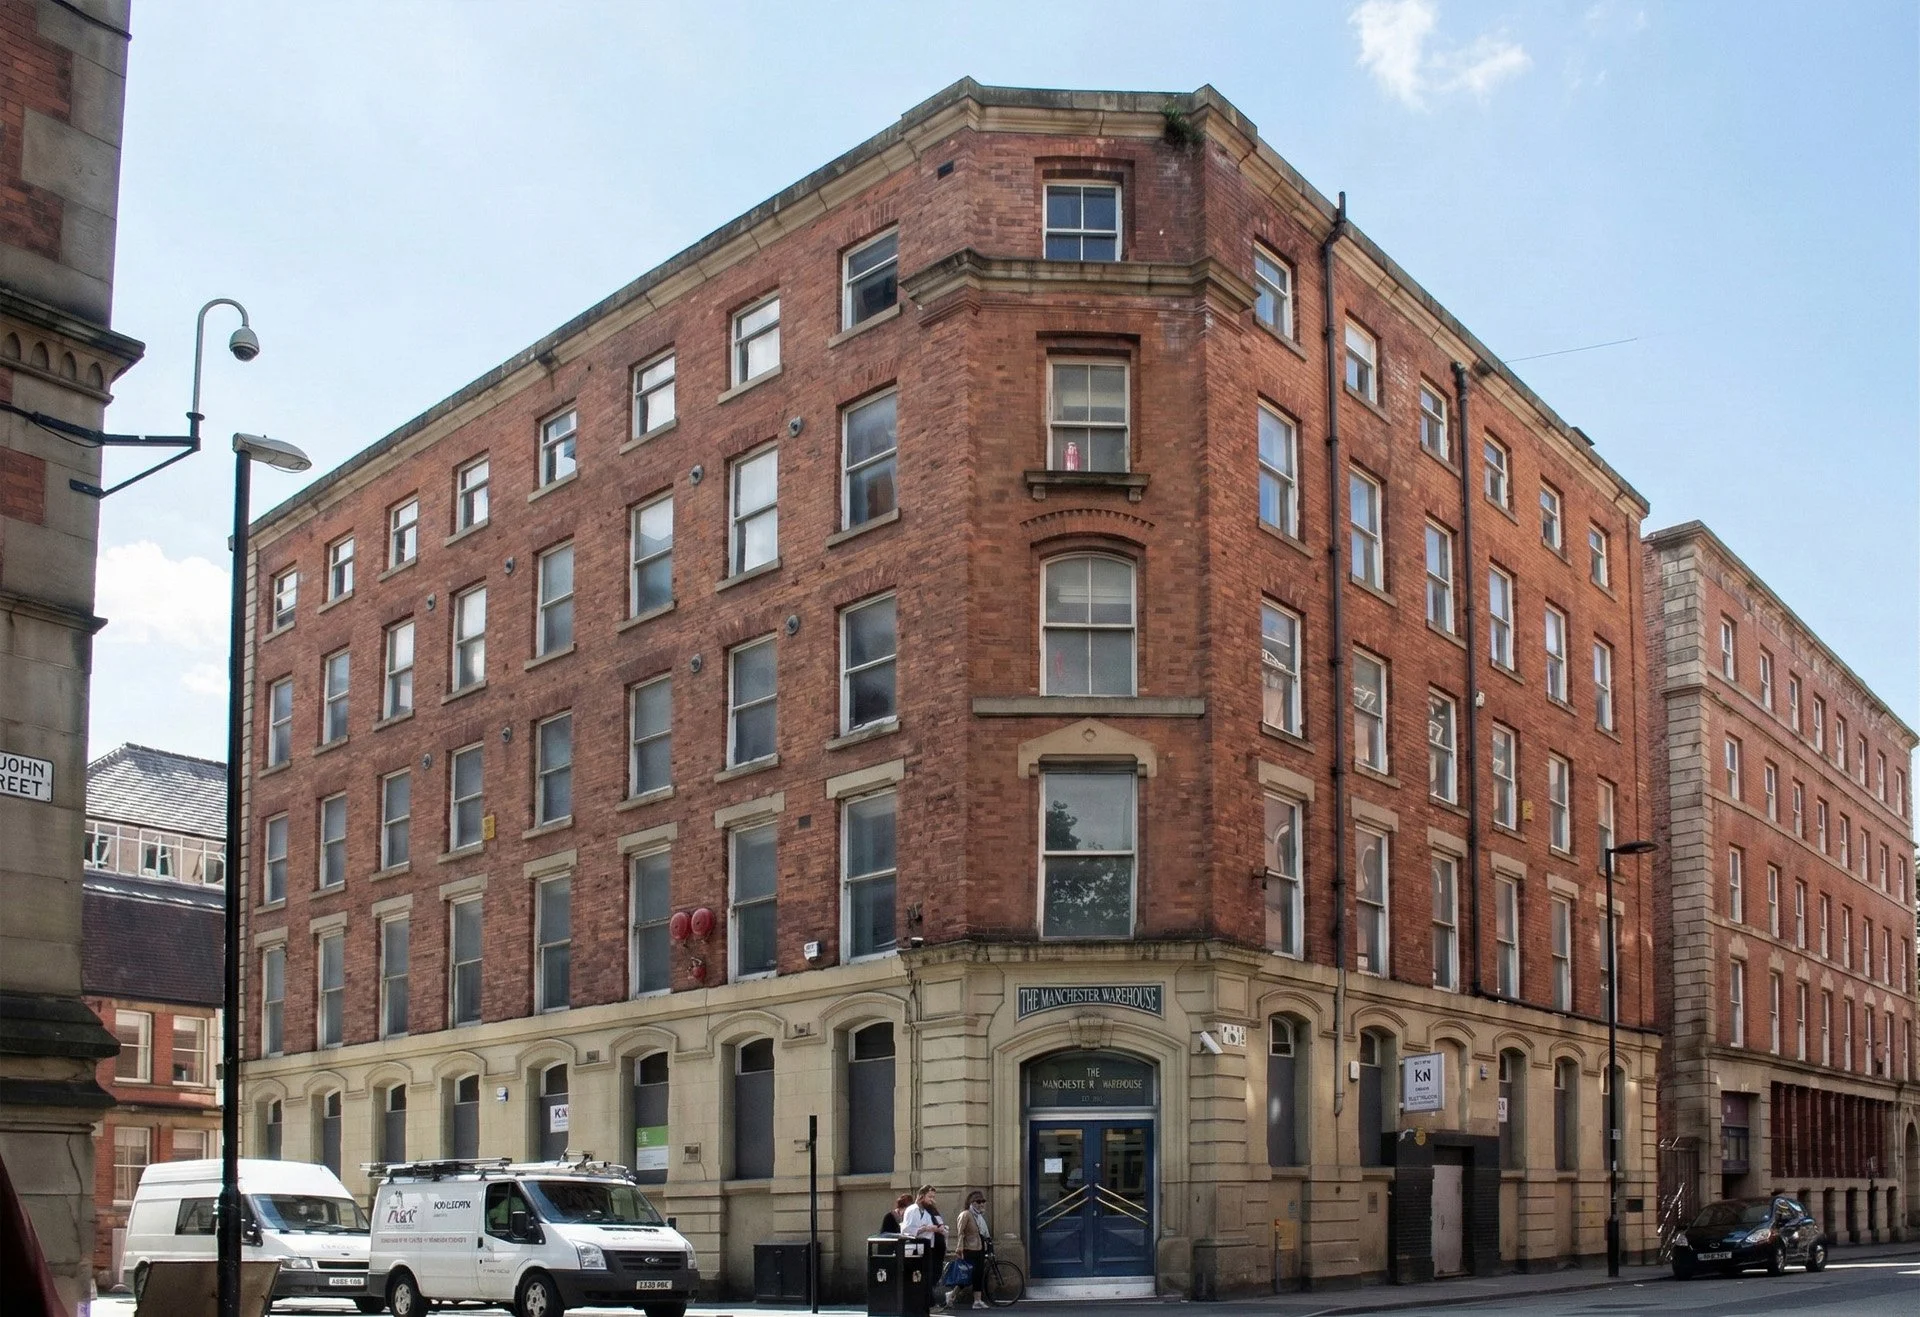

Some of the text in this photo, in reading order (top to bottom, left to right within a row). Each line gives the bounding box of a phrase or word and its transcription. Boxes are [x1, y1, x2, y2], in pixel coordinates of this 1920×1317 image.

[0, 756, 44, 778] JOHN
[1020, 987, 1156, 1014] THE MANCHESTER WAREHOUSE
[1086, 1067, 1100, 1077] THE
[1415, 1068, 1431, 1082] KN
[1102, 1079, 1142, 1089] WAREHOUSE
